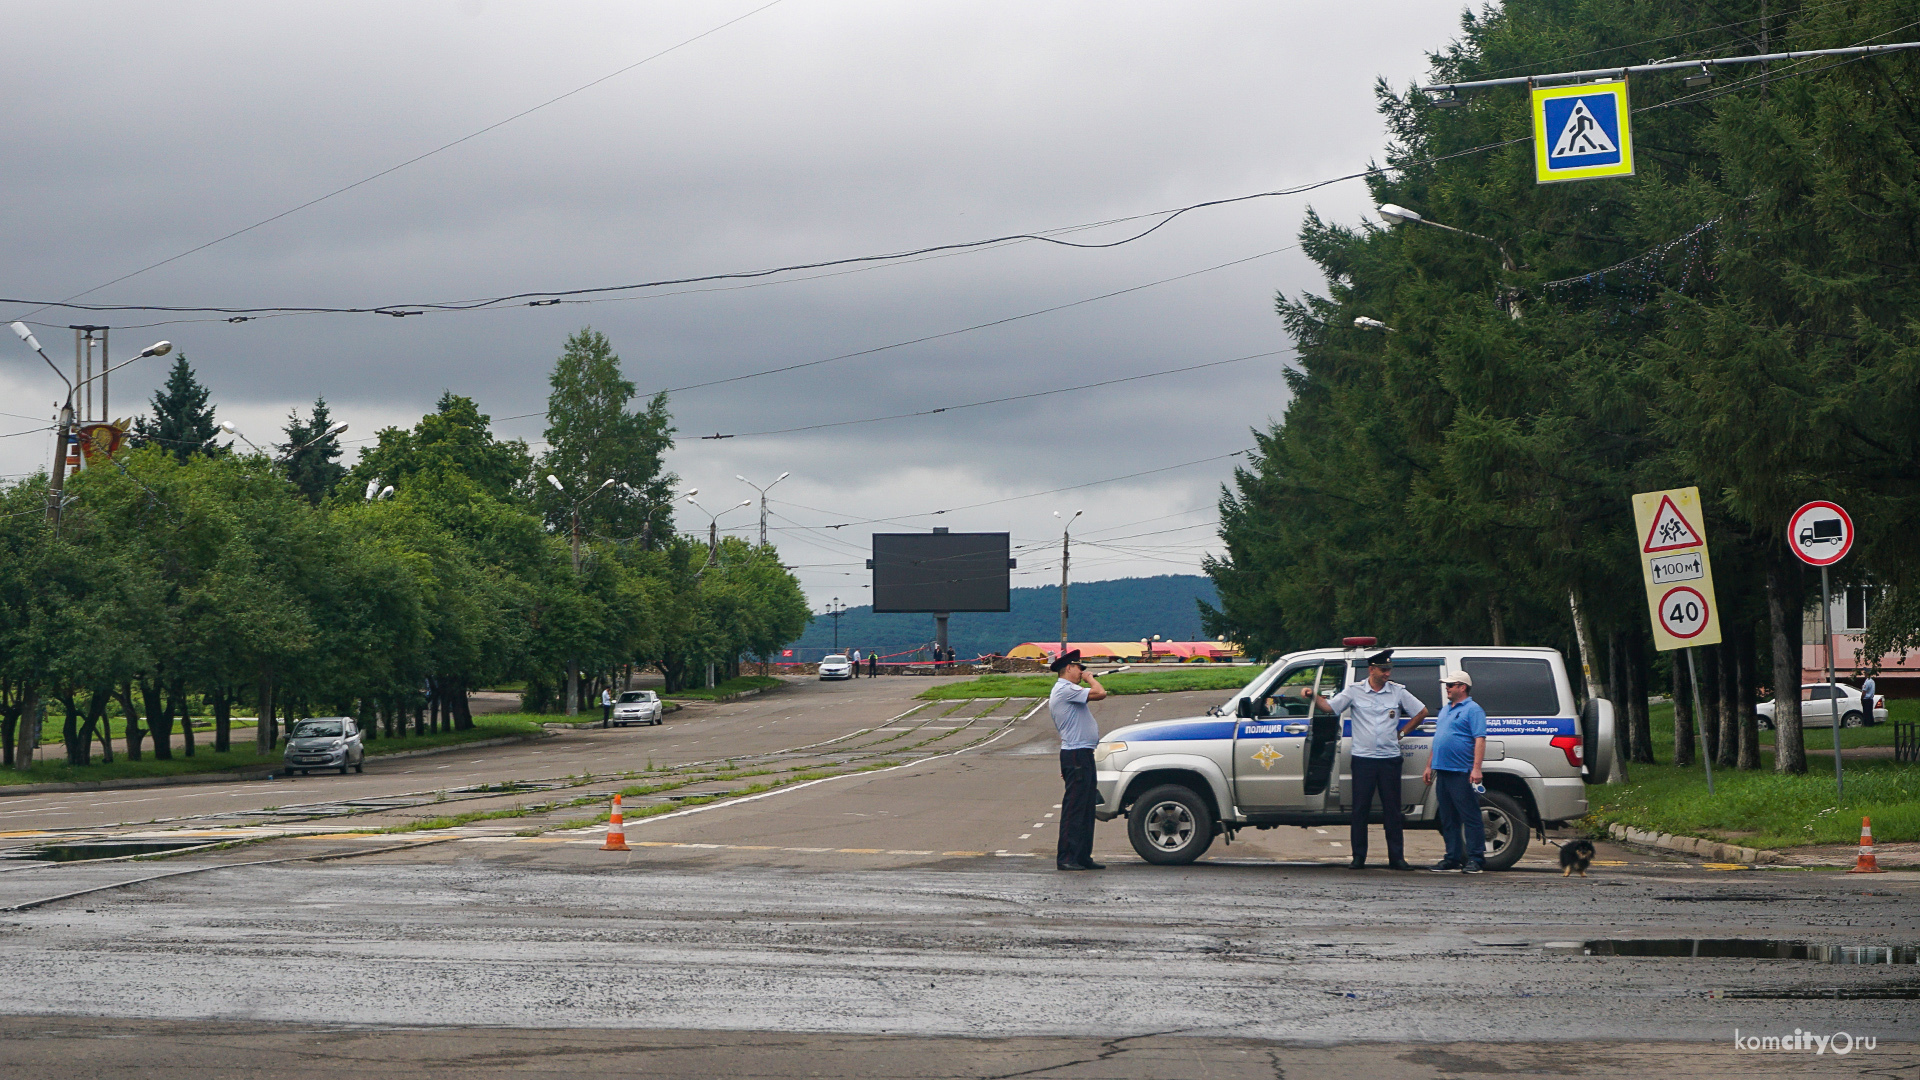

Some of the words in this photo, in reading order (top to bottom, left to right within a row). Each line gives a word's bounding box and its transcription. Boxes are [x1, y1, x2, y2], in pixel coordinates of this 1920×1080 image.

[1670, 602, 1698, 623] 40
[1522, 718, 1548, 726] России
[1245, 725, 1282, 734] ПОЛИЦИЯ
